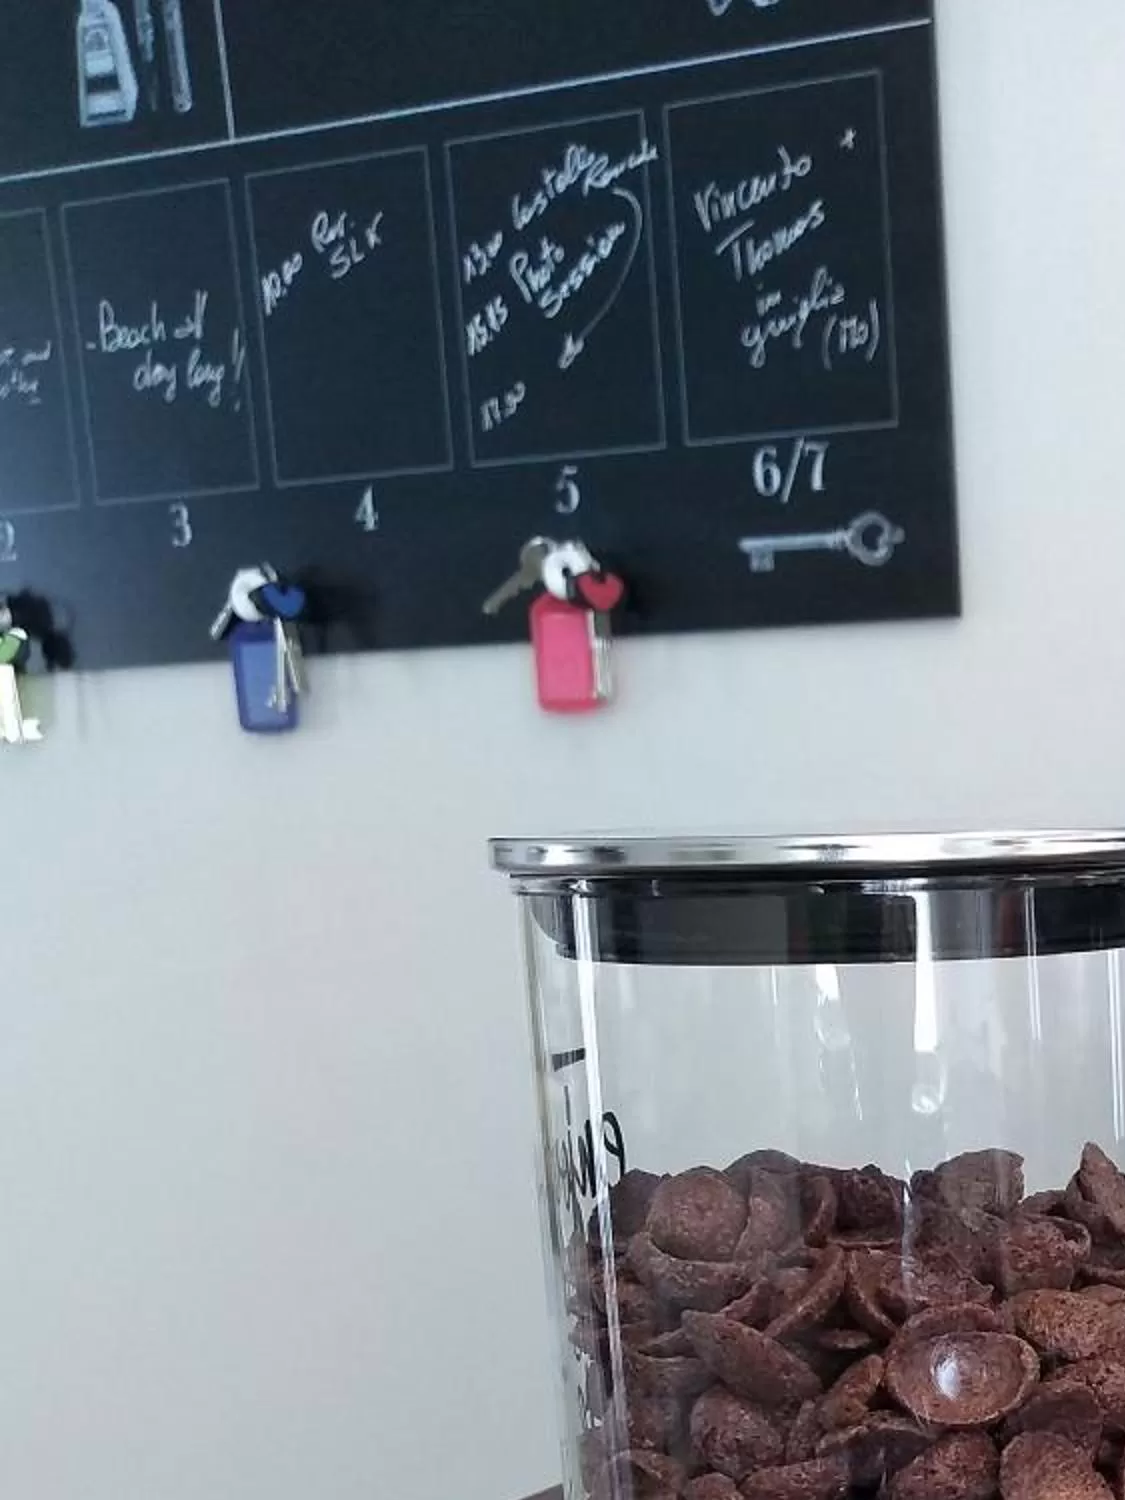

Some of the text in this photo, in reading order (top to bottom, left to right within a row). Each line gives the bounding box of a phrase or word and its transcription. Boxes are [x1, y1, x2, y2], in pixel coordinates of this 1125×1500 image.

[715, 199, 825, 283] Thomas
[99, 299, 166, 353] Beach
[132, 349, 177, 403] day
[555, 465, 581, 513] 5
[752, 437, 829, 502] 6/7
[169, 503, 193, 548] 3
[354, 485, 379, 532] 4
